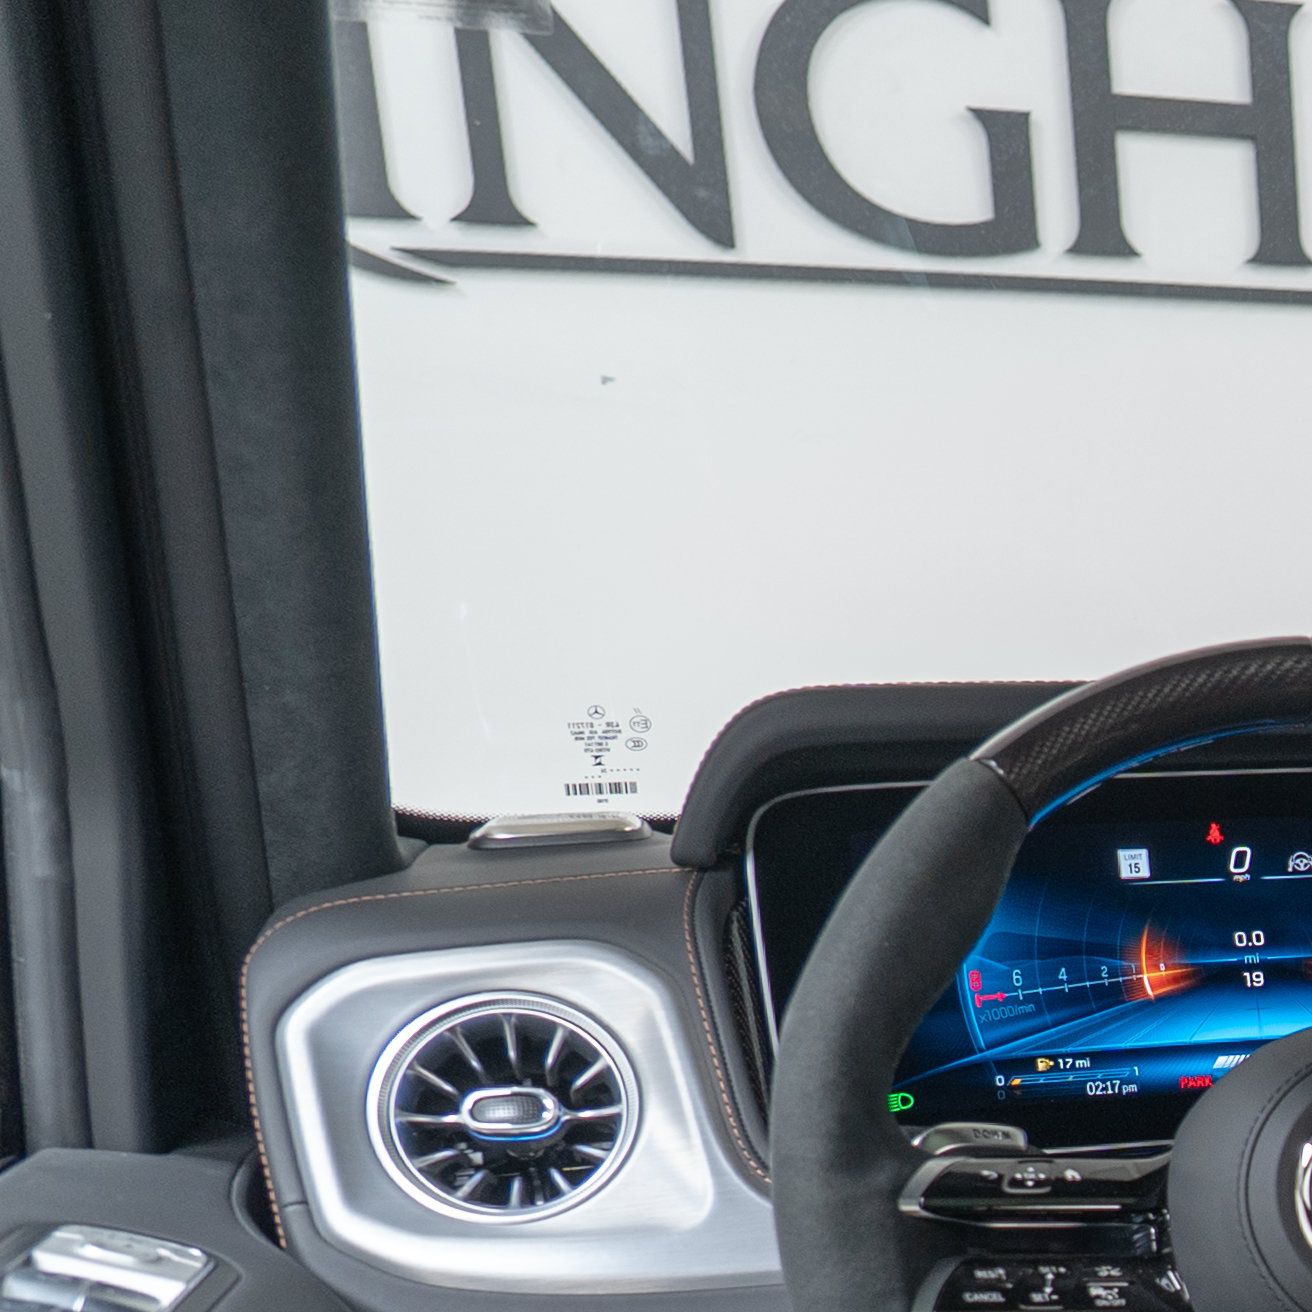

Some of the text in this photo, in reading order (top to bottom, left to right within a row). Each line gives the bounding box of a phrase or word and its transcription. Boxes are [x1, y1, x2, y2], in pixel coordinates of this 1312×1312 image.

[1123, 853, 1143, 861] LIMIT
[1229, 846, 1251, 874] 0
[1128, 863, 1141, 874] 15
[1234, 930, 1265, 947] 0.0
[1244, 953, 1260, 964] mi
[1012, 969, 1023, 987] 6
[1058, 967, 1068, 981] 4
[1101, 965, 1109, 977] 2
[1242, 971, 1265, 988] 19
[1057, 1057, 1091, 1069] 17 mi
[1134, 1066, 1140, 1076] 1
[995, 1075, 1005, 1087] 0
[1086, 1080, 1138, 1096] 02:17 pm
[972, 1128, 1012, 1139] DOWN
[962, 1291, 1006, 1303] CANCEL
